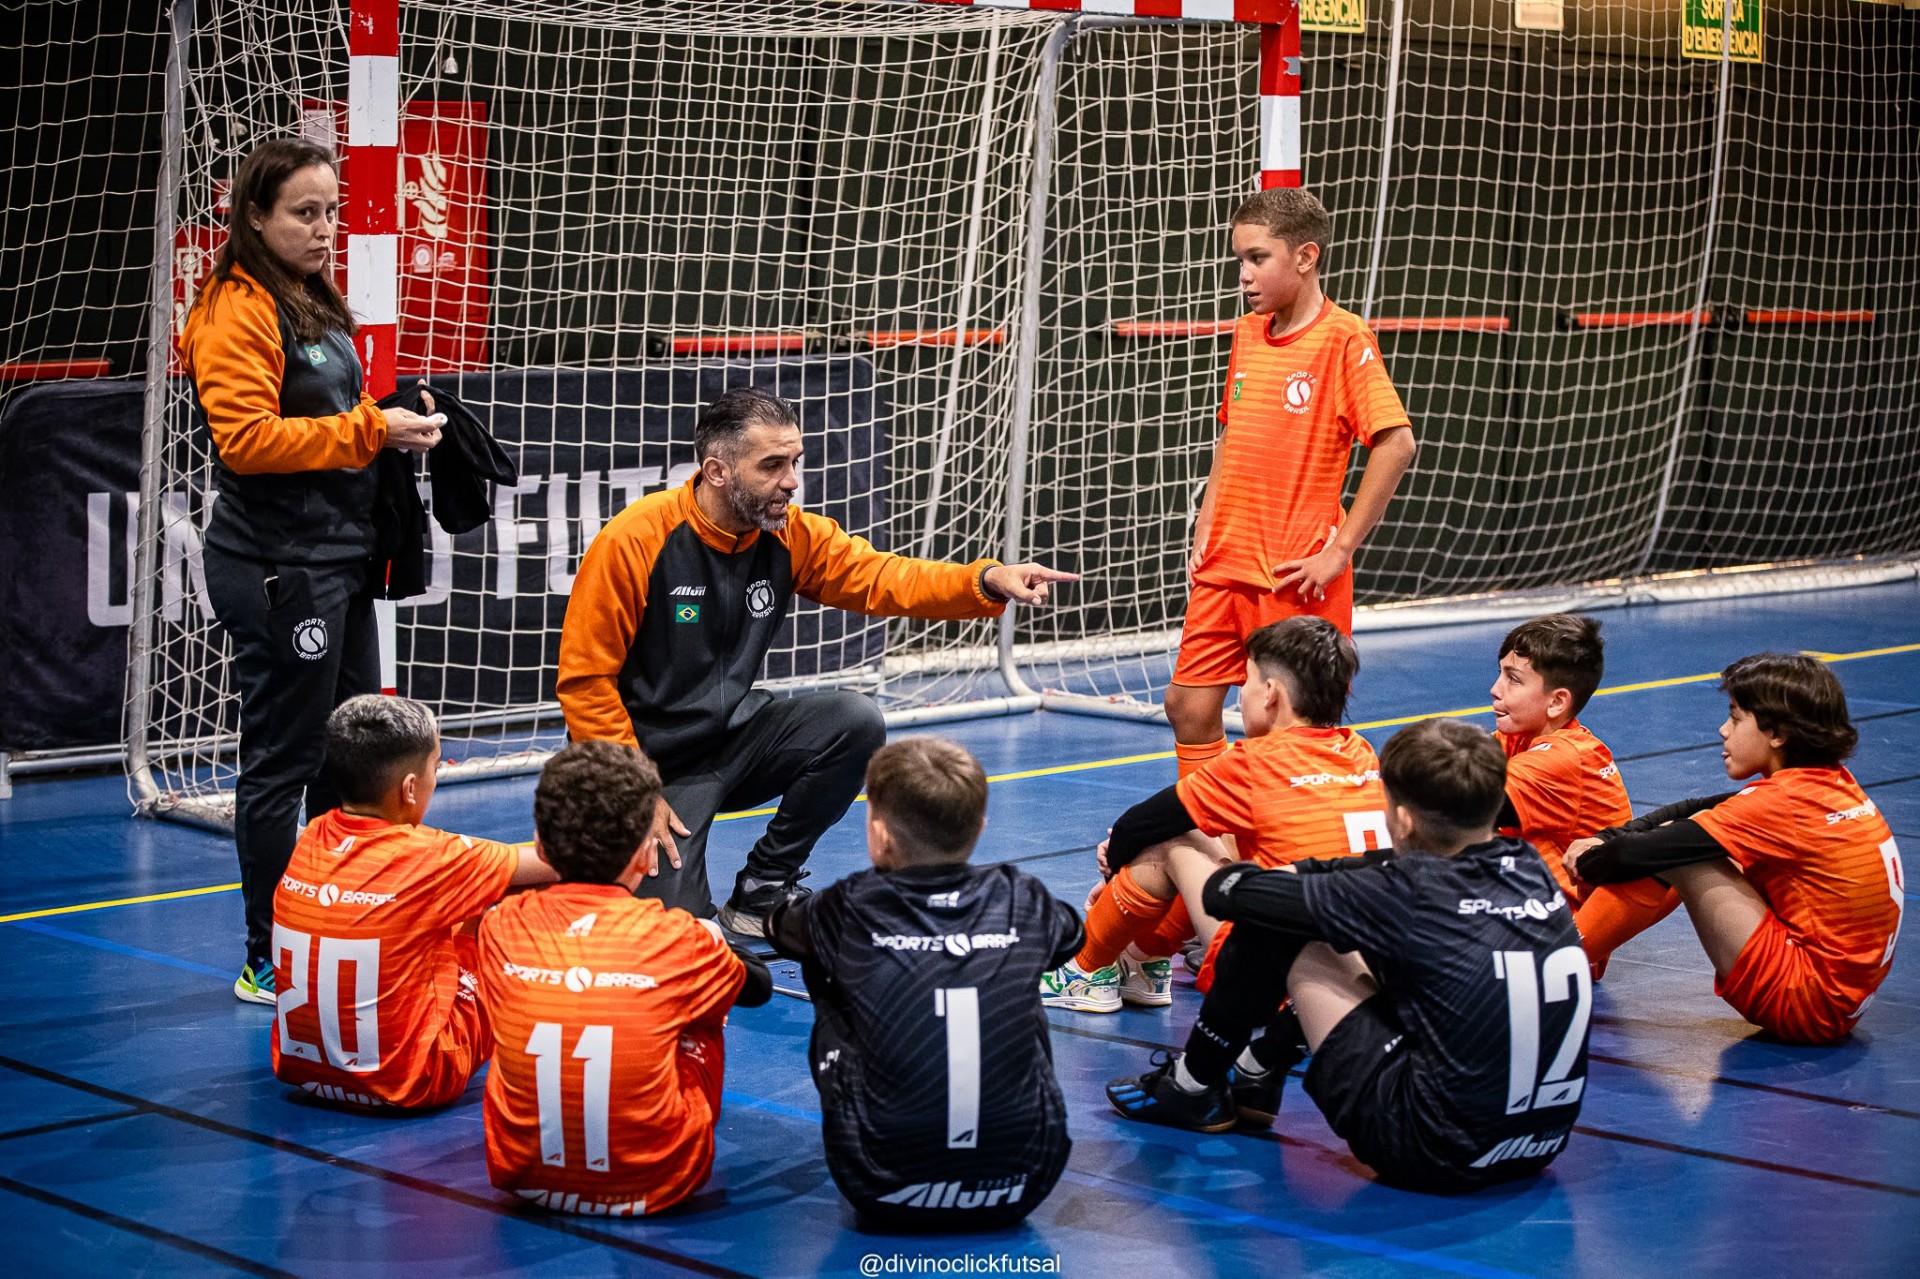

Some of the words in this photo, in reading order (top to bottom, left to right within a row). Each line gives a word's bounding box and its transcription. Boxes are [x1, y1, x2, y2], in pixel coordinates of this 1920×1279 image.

[1685, 24, 1759, 55] D'EMERÈNCIA
[1286, 371, 1318, 385] SPORTS
[1283, 403, 1310, 415] BRASIL
[746, 579, 771, 595] SPOR
[293, 618, 327, 634] SPORTS
[281, 874, 319, 899] PORTS
[503, 962, 565, 985] SPORTS
[594, 972, 659, 988] BRASIL
[271, 921, 380, 1072] 20
[1493, 946, 1593, 1116] 12
[934, 987, 981, 1149] 1
[525, 1022, 613, 1172] 11
